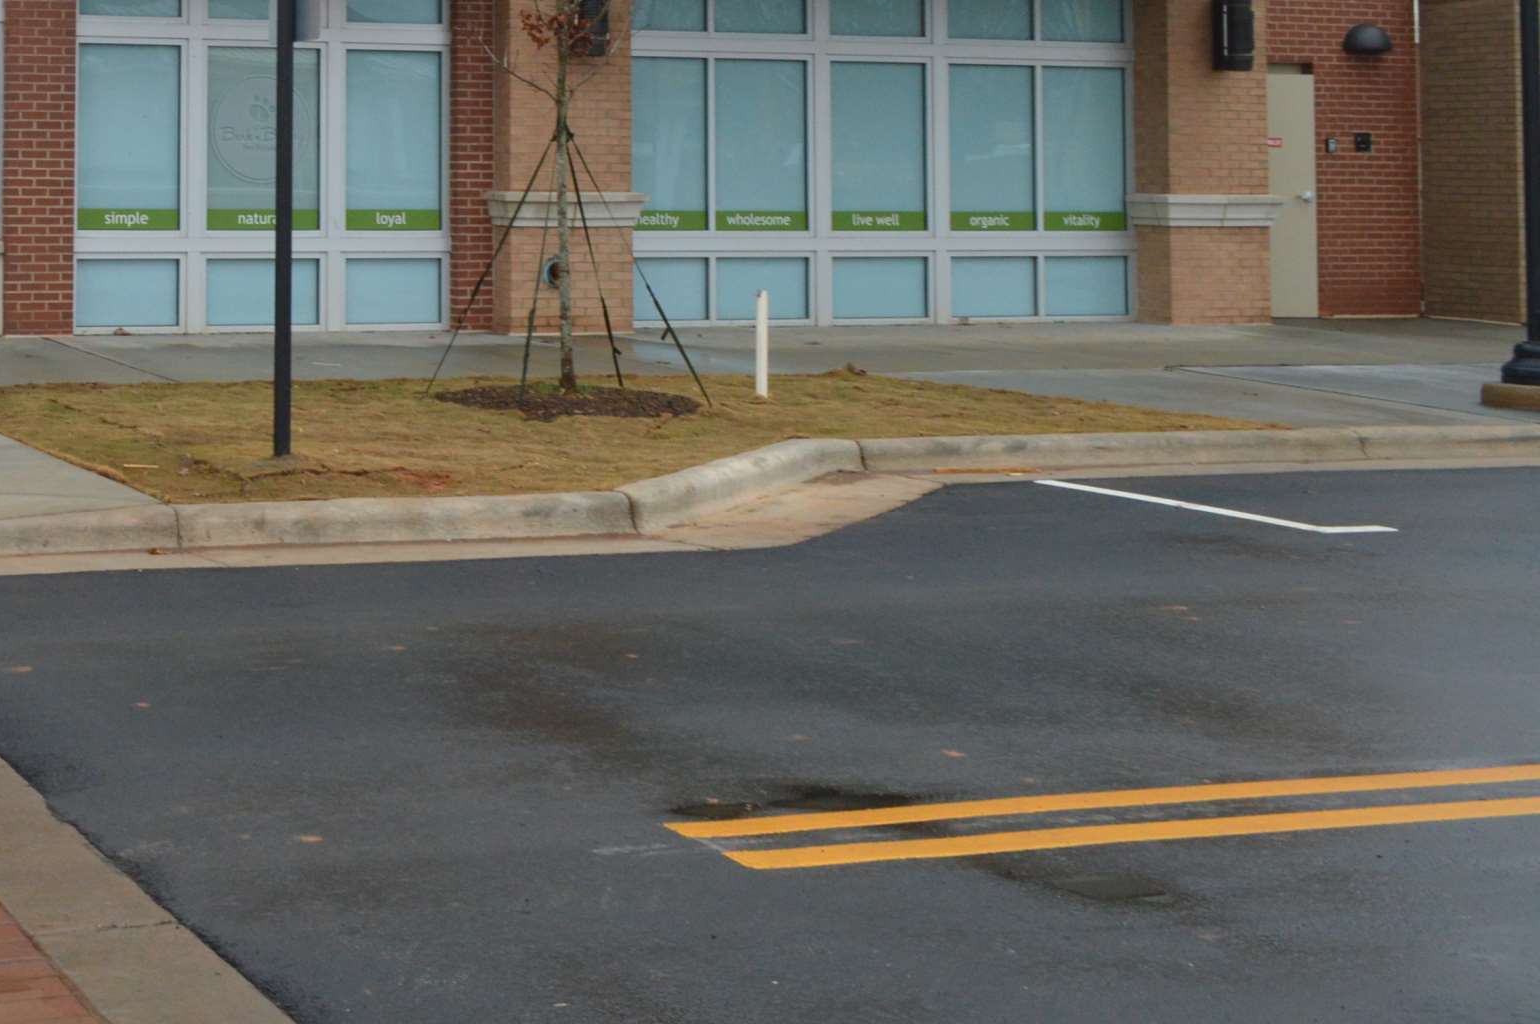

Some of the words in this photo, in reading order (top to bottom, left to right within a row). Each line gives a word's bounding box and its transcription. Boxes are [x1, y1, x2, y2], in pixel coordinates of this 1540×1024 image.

[104, 211, 149, 227] simple
[237, 212, 276, 225] natura
[375, 212, 407, 227] loyal
[726, 213, 791, 226] wholesome
[852, 214, 873, 226] live
[875, 214, 900, 226] well
[969, 214, 1010, 229] organic
[1062, 214, 1101, 228] vitality
